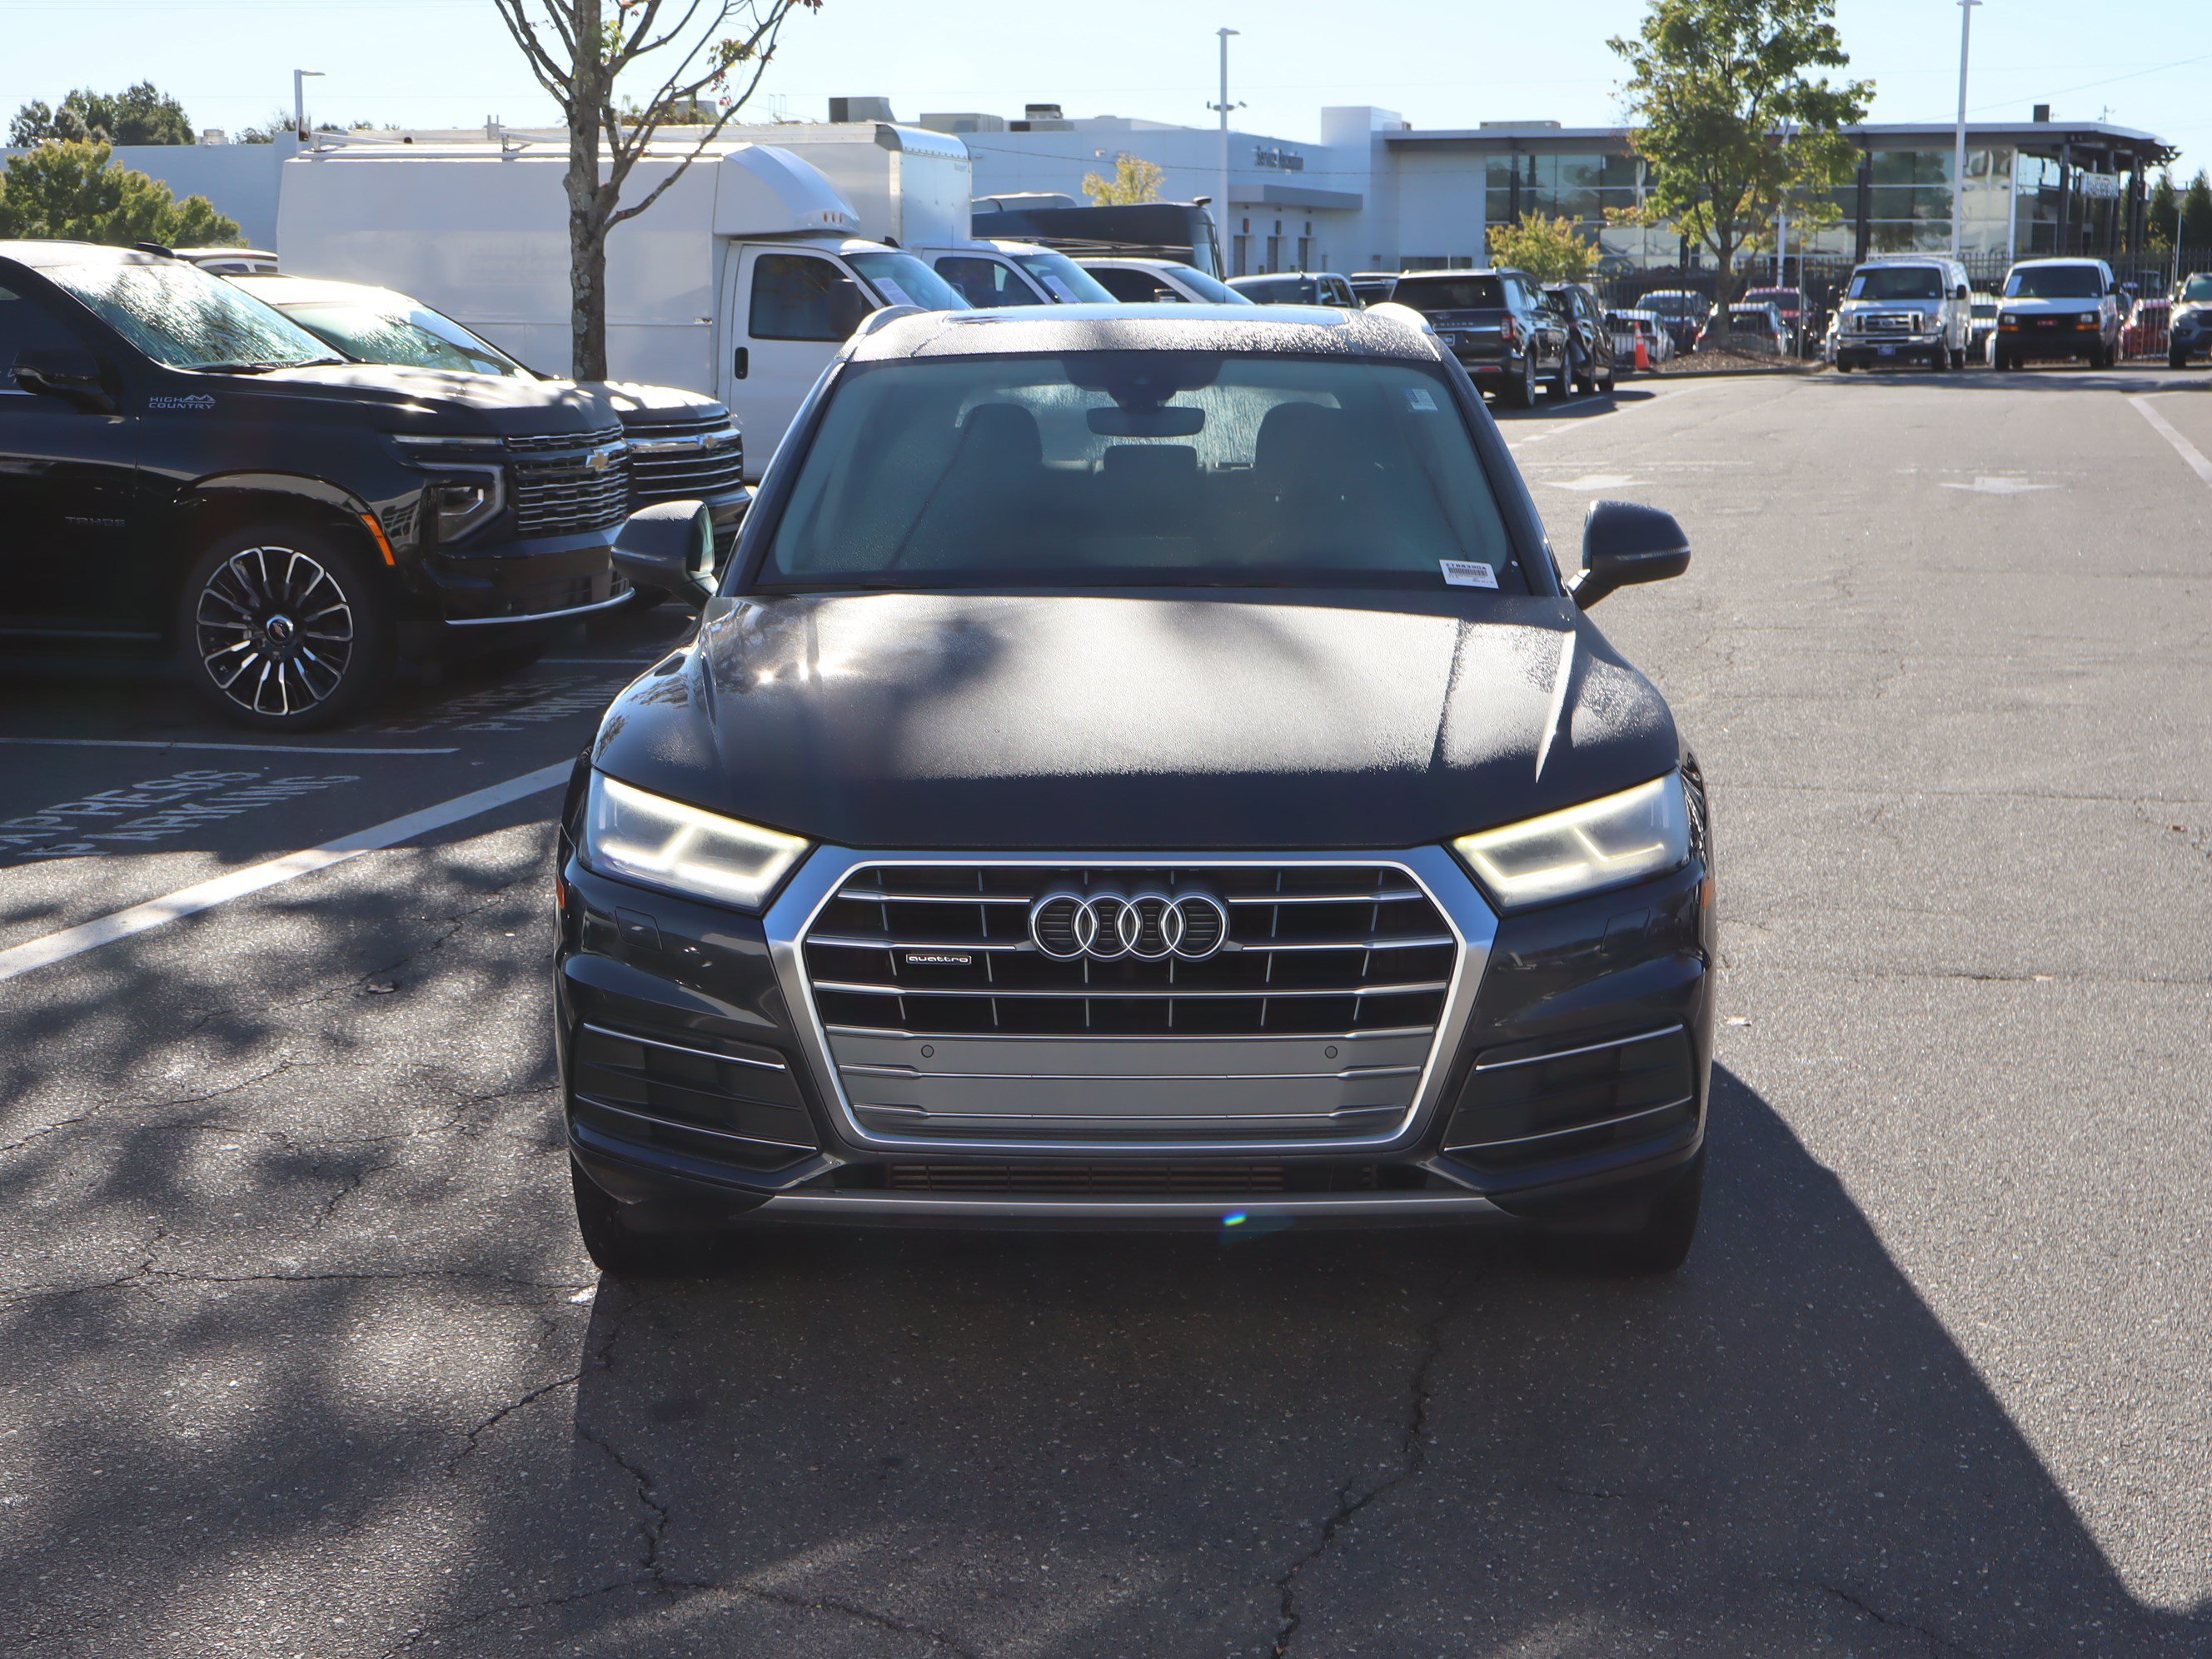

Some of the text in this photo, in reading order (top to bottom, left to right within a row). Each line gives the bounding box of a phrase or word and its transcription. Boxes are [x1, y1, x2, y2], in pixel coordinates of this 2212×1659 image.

[64, 516, 126, 527] TAHOE
[17, 775, 361, 857] PARKING
[908, 955, 969, 964] quattro
